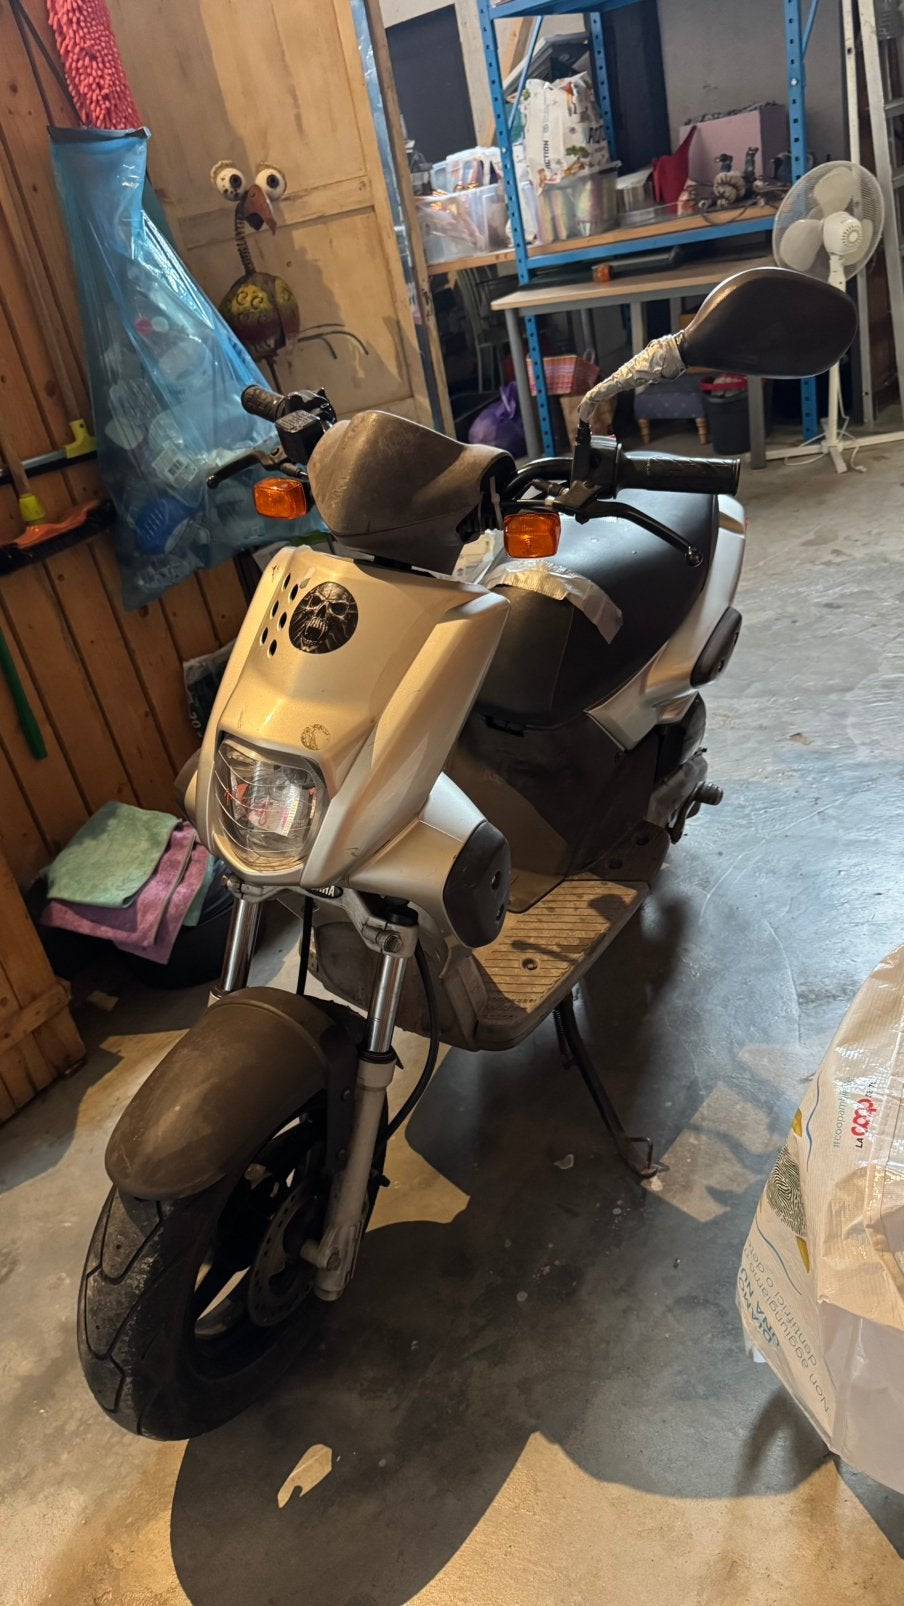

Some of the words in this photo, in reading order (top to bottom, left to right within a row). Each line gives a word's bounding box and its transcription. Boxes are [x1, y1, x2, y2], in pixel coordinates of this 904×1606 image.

[855, 1138, 864, 1149] LA
[766, 1277, 774, 1288] o
[738, 1276, 772, 1343] DIAMO
[749, 1262, 809, 1368] aggiungiamo
[756, 1300, 779, 1346] UNA
[774, 1291, 817, 1366] dentifrici
[809, 1373, 830, 1412] Non
